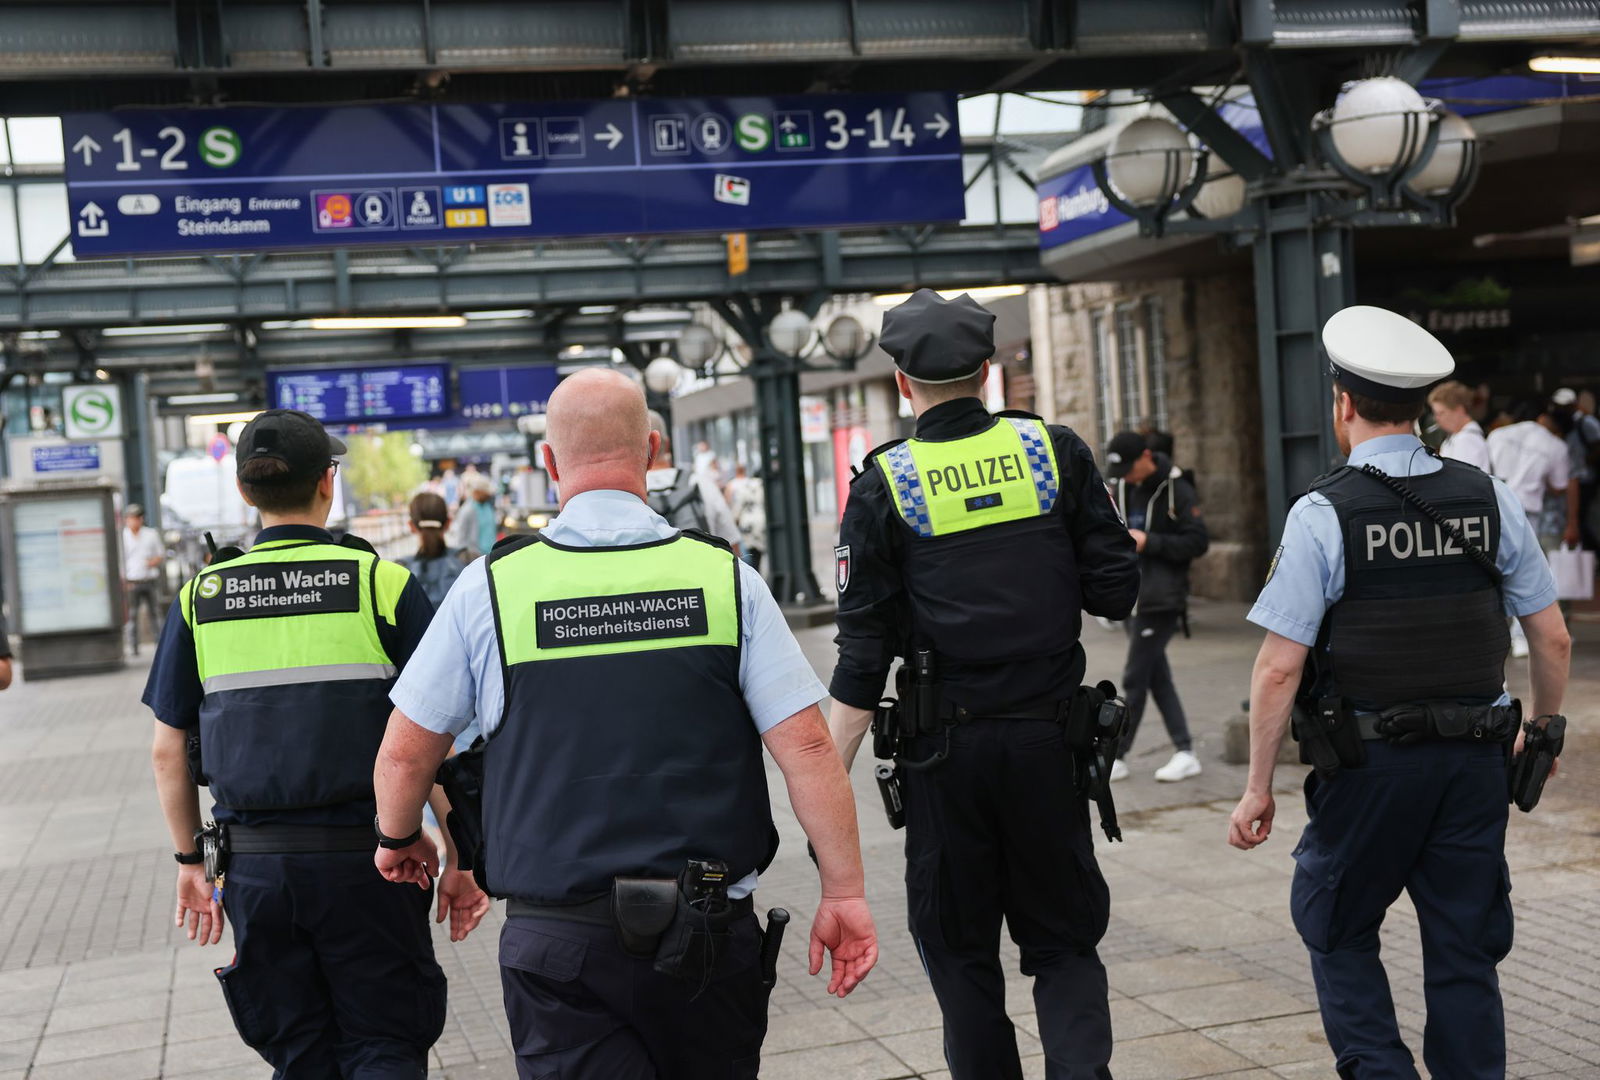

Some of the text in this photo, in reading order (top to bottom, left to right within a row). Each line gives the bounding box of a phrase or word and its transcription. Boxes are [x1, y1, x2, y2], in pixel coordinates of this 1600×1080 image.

[823, 108, 915, 150] 3-14
[112, 126, 188, 171] 1-2
[175, 195, 300, 215] Eingang Entrance
[452, 187, 475, 203] U1
[177, 216, 270, 236] Steindamm
[453, 211, 478, 225] U3
[1428, 310, 1510, 332] Express
[926, 454, 1024, 496] POLIZEI
[1366, 516, 1490, 561] POLIZEI
[225, 570, 350, 594] Bahn Wache
[225, 591, 322, 610] DB Sicherheit
[543, 596, 700, 622] HOCHBAHN-WACHE
[554, 614, 690, 639] Sicherheitsdienst
